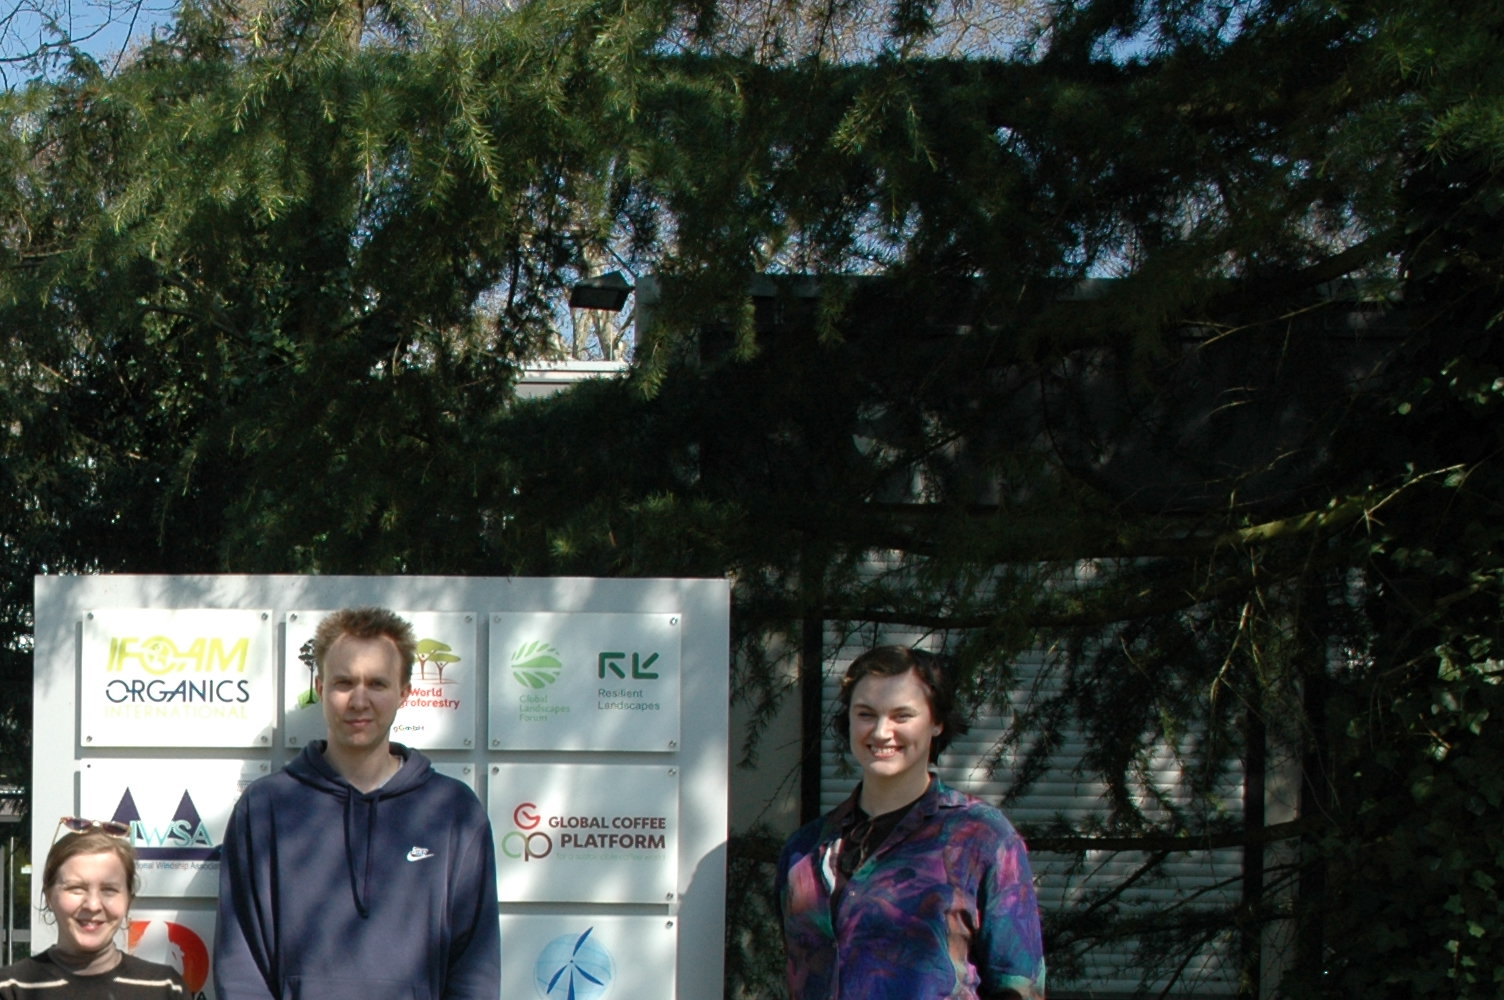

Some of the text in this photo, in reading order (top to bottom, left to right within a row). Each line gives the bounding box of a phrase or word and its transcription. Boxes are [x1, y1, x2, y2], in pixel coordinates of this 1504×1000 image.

[106, 635, 250, 675] IFOAM
[105, 679, 250, 703] ORGANICS
[410, 687, 443, 697] World
[598, 688, 643, 698] Resilient
[519, 694, 548, 703] Global
[519, 704, 571, 714] Landscapes
[598, 701, 660, 711] Landscapes
[105, 704, 248, 720] INTERNATIONAL
[519, 713, 548, 721] Forum
[548, 816, 666, 829] GLOBAL COFFEE
[129, 819, 213, 847] IWSA
[560, 833, 666, 849] PLATFORM
